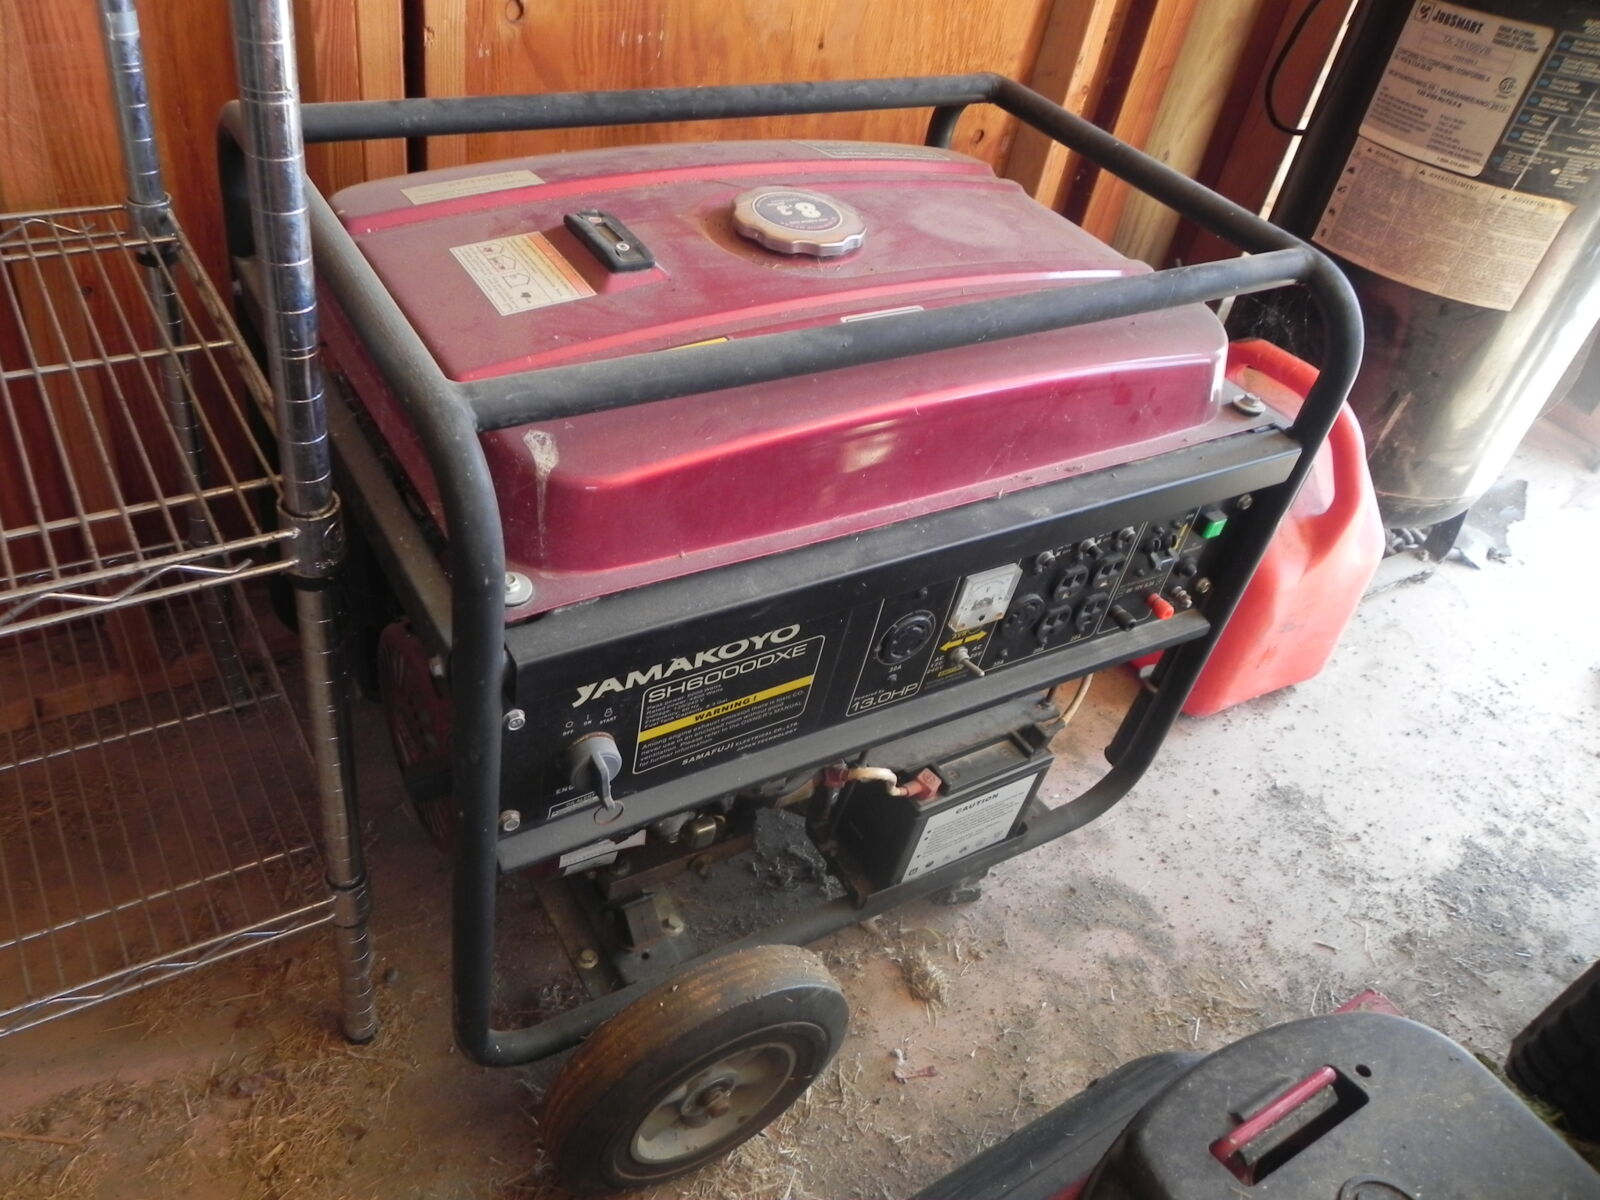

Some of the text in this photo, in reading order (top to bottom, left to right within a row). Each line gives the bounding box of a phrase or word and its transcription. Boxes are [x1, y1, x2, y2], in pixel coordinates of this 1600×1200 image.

[572, 624, 800, 707] YAMAKOYO
[647, 643, 808, 703] SH6000DXE
[851, 682, 918, 711] 13.0HP
[854, 688, 878, 701] Powered
[600, 716, 617, 724] START
[694, 697, 750, 722] WARNING
[641, 745, 660, 755] never
[694, 723, 723, 736] enclosed
[725, 716, 742, 725] room
[744, 707, 766, 719] without
[642, 737, 666, 750] Among
[669, 728, 691, 741] engine
[693, 718, 719, 731] exhaust
[680, 736, 702, 747] Please
[704, 729, 720, 738] refer
[650, 751, 673, 763] further
[681, 741, 734, 765] SAMAFUJI
[956, 793, 1000, 814] CAUTION
